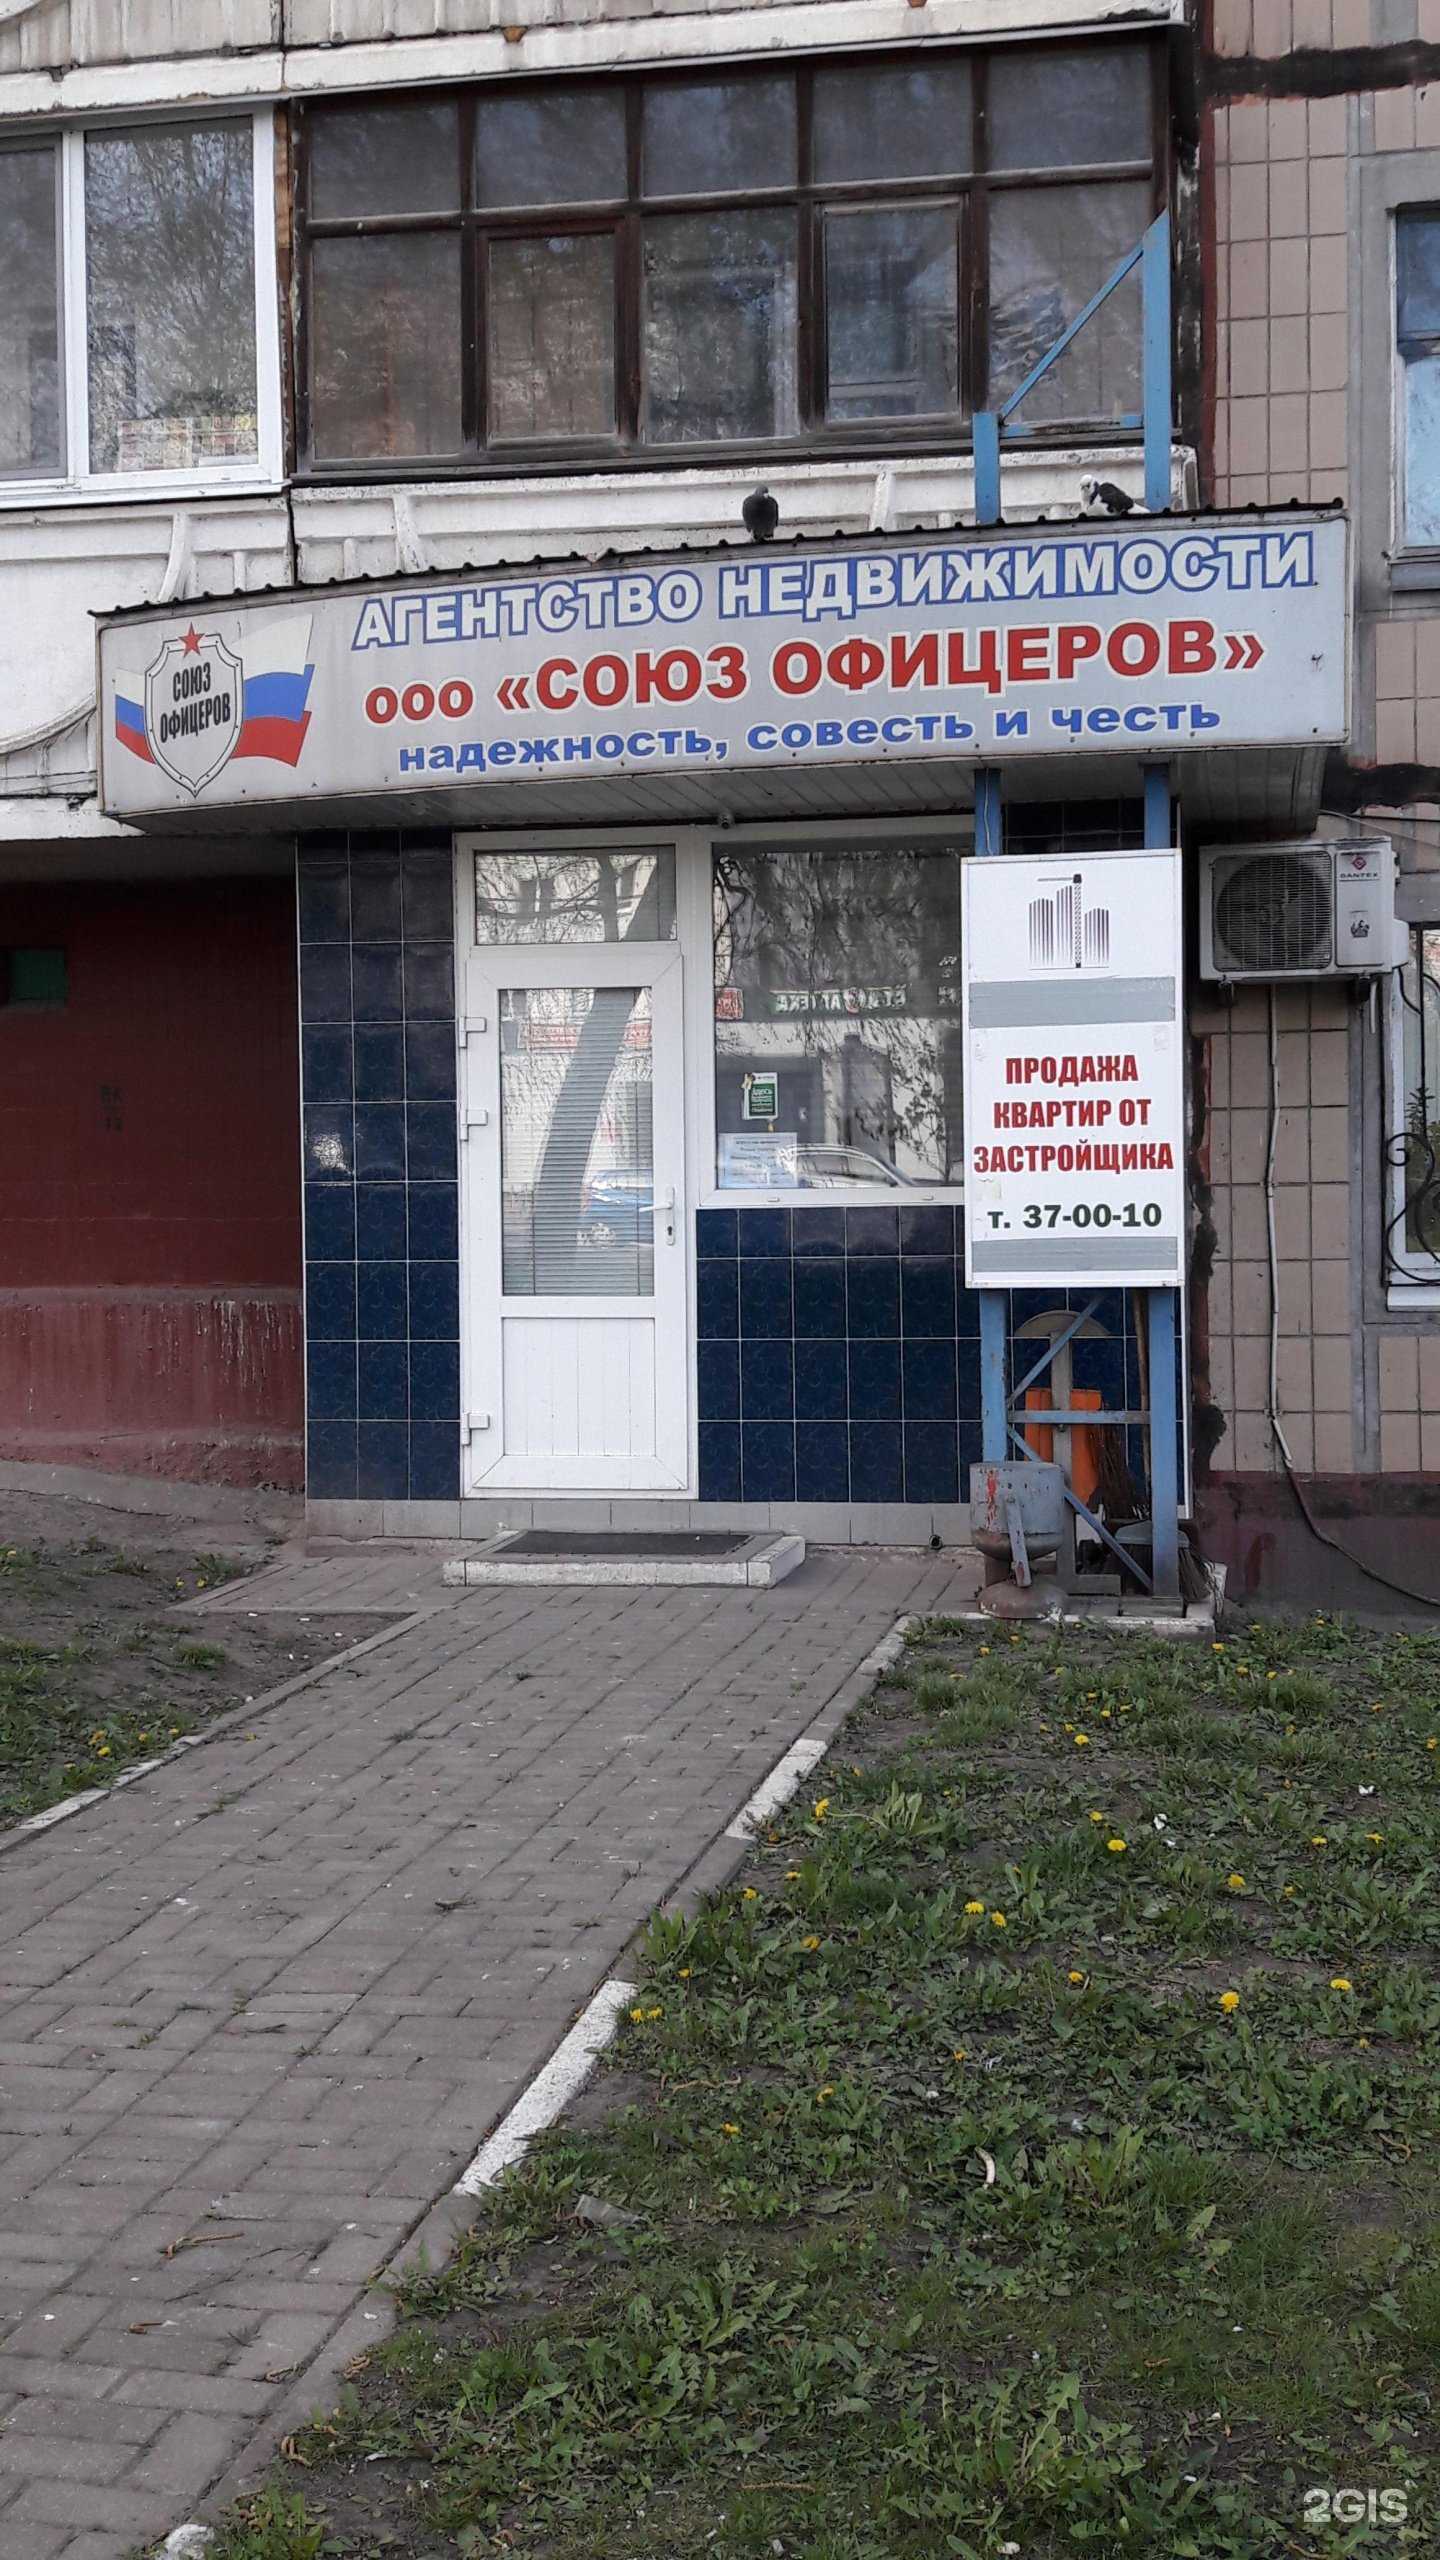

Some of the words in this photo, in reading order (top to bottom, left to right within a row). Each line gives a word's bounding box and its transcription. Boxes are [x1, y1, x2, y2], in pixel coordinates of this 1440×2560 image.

[352, 571, 704, 651] АГЕНТСТВО
[719, 531, 1313, 621] НЕДВИЖИМОСТИ
[172, 661, 212, 704] СОЮЗ
[496, 645, 747, 711] «СОЮЗ
[772, 620, 1265, 692] ОФИЦЕРОВ»
[160, 693, 231, 744] ОФИЦЕРОВ
[400, 728, 728, 772] надежность,
[747, 714, 974, 751] совесть
[996, 711, 1028, 736] и
[1053, 704, 1221, 733] честь
[1005, 1054, 1139, 1088] ПРОДАЖА
[993, 1099, 1112, 1129] КВАРТИР
[1119, 1098, 1151, 1126] ОТ
[974, 1139, 1174, 1174] ЗАСТРОЙЩИКА
[1022, 1203, 1163, 1229] 37-00-10
